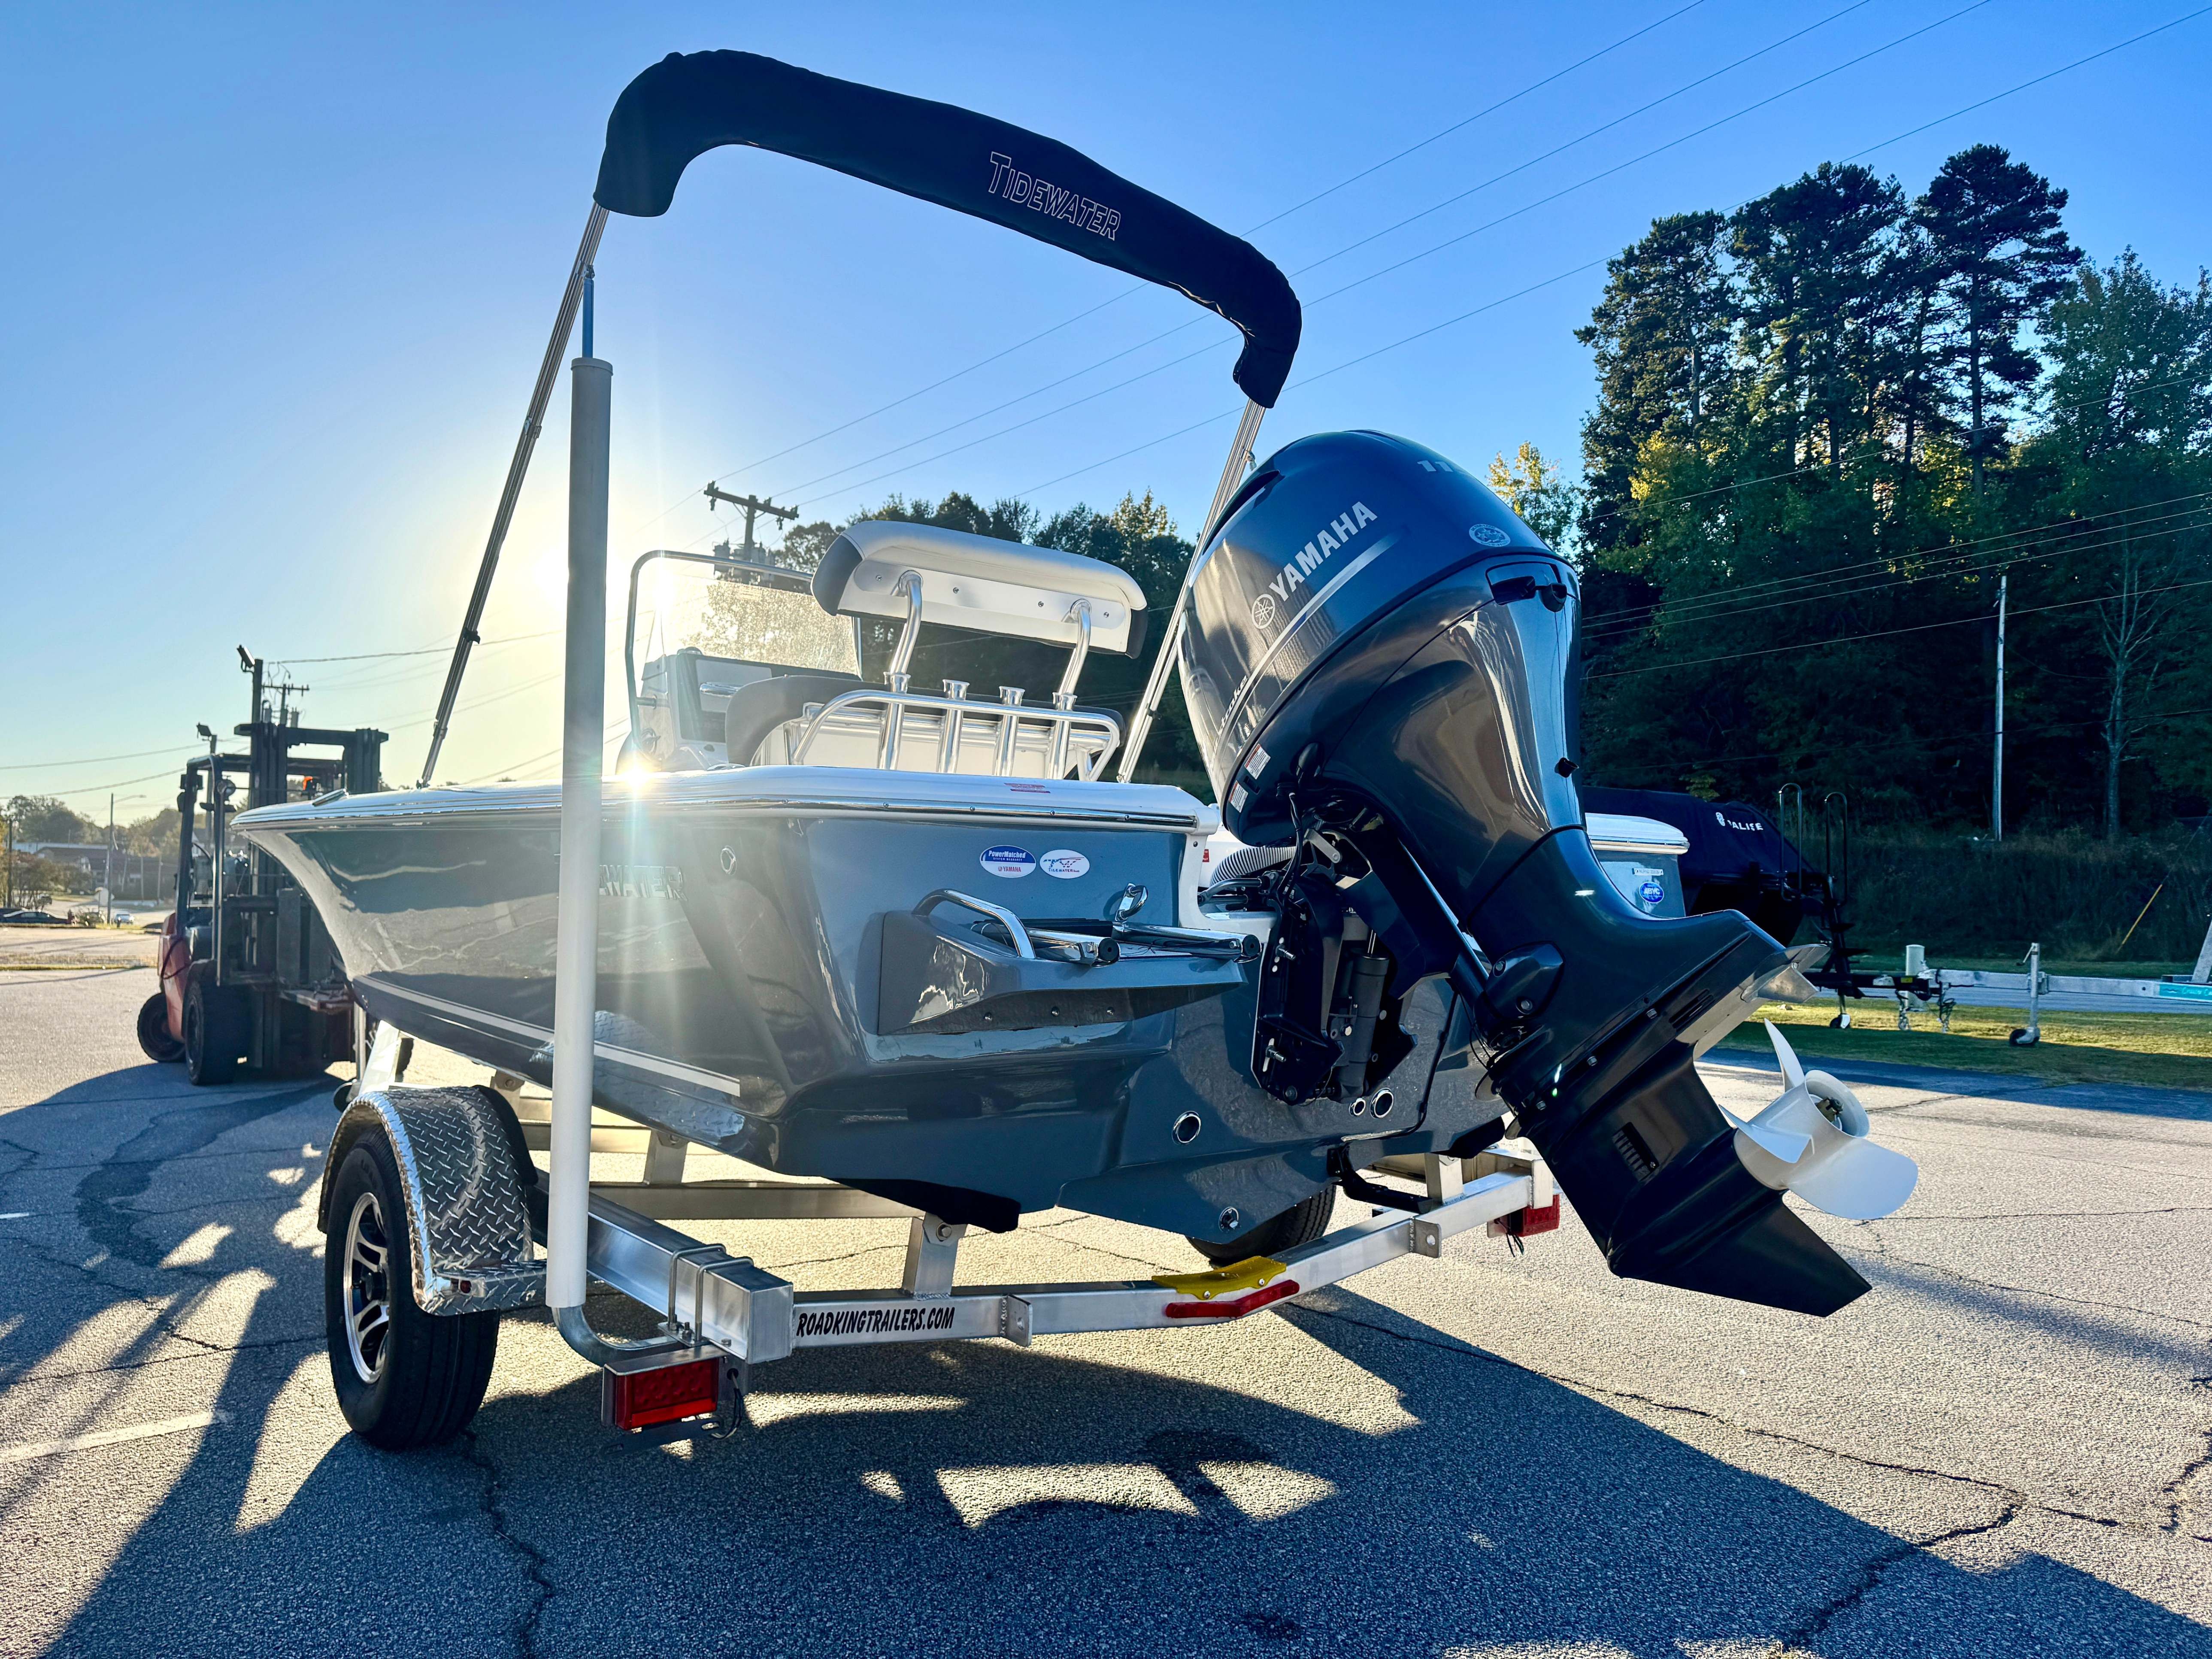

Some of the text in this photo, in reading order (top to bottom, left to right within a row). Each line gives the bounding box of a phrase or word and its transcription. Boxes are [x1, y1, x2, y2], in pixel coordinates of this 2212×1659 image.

[988, 152, 1121, 240] TIDEWATER
[1269, 501, 1378, 601] YAMAHA
[988, 850, 1026, 858] PowerMatched
[796, 1307, 955, 1337] ROADKINGTRAILERS.COM
